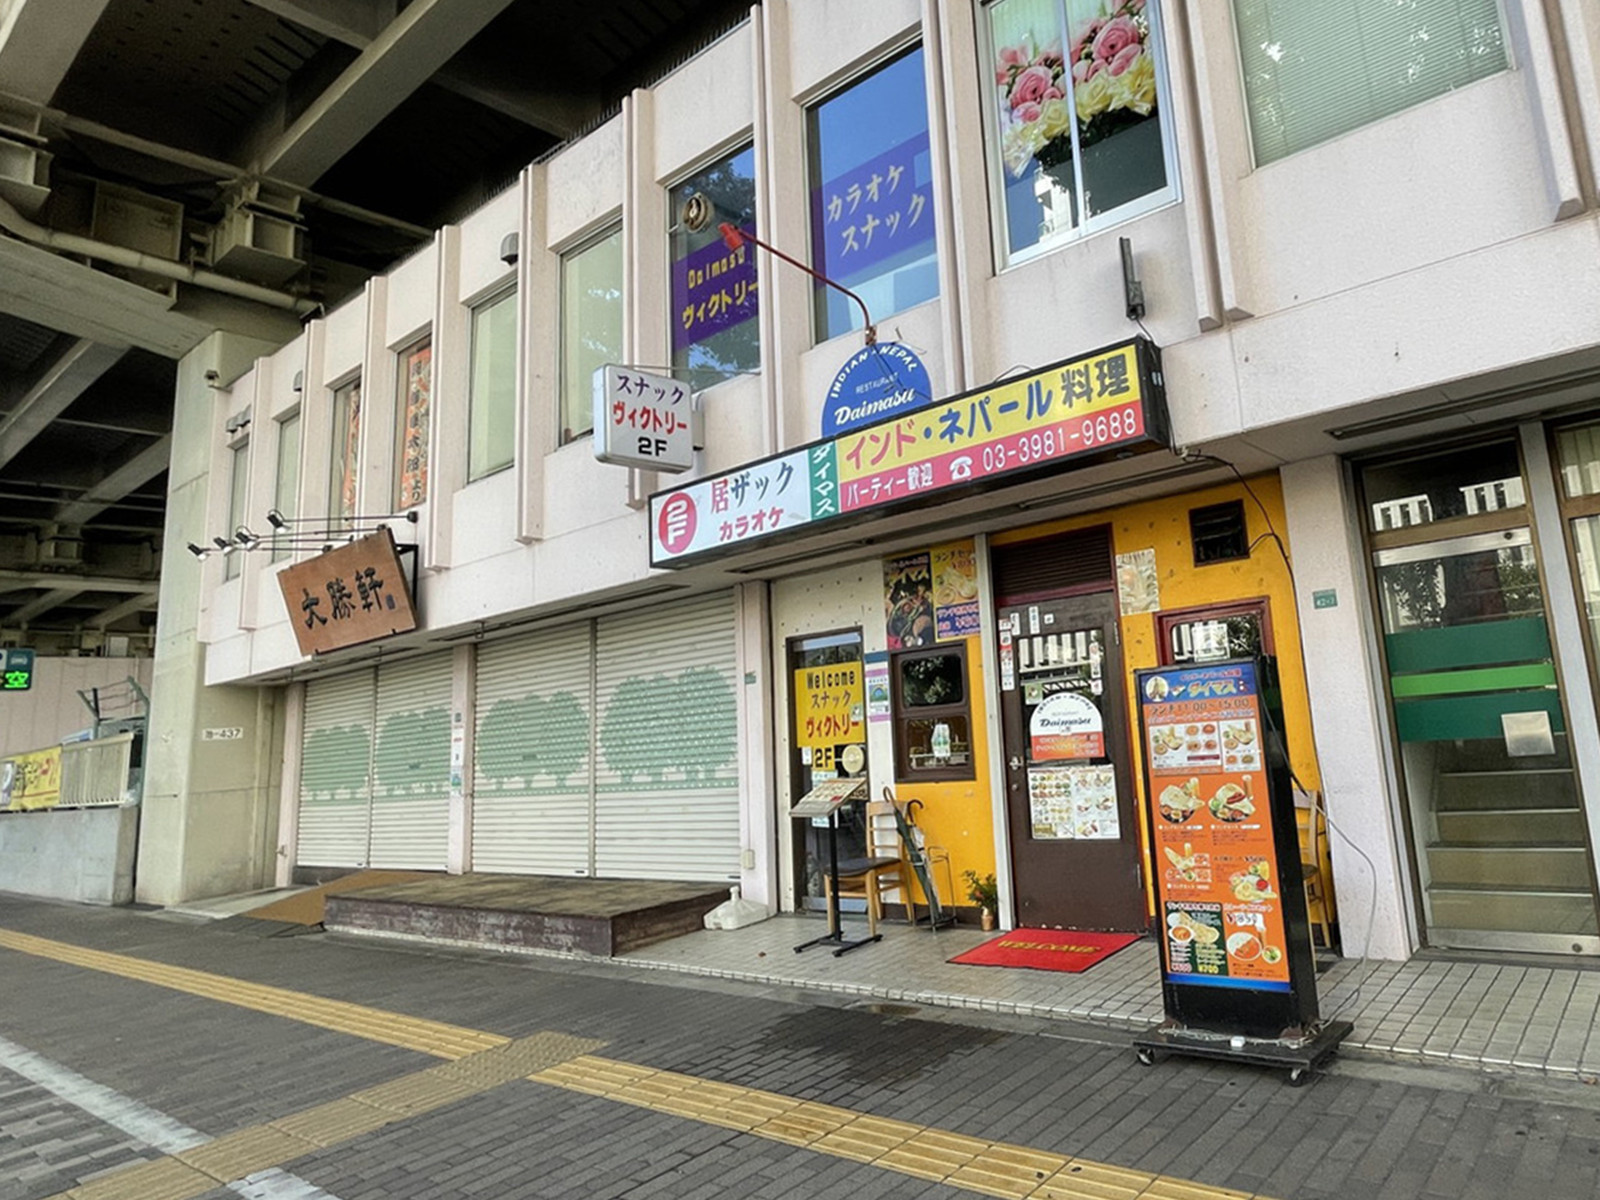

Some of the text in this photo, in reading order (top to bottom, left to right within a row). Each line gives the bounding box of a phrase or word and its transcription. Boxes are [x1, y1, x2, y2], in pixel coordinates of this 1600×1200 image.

[827, 165, 904, 224] カラオケ
[841, 193, 926, 258] スナック
[682, 280, 758, 330] ヴィクトリー
[616, 374, 685, 405] スナック
[830, 345, 918, 398] INDIAN NEPAL
[612, 401, 688, 435] ヴィクトリー
[834, 388, 916, 426] Daimasu
[637, 436, 668, 457] 2F
[983, 408, 1136, 472] 03-3981-9688
[711, 461, 794, 514] 居ザック
[813, 441, 836, 516] ダイマス
[847, 463, 934, 506] パーティー歓迎
[666, 501, 689, 546] 2F
[719, 507, 785, 541] カラオケ
[302, 567, 384, 629] 大勝軒
[5, 672, 29, 688] 空
[807, 670, 855, 691] Welcome
[811, 691, 851, 710] スナック
[806, 713, 860, 738] ヴィクトリー
[814, 748, 833, 768] 2F
[997, 939, 1098, 954] WELCOME
